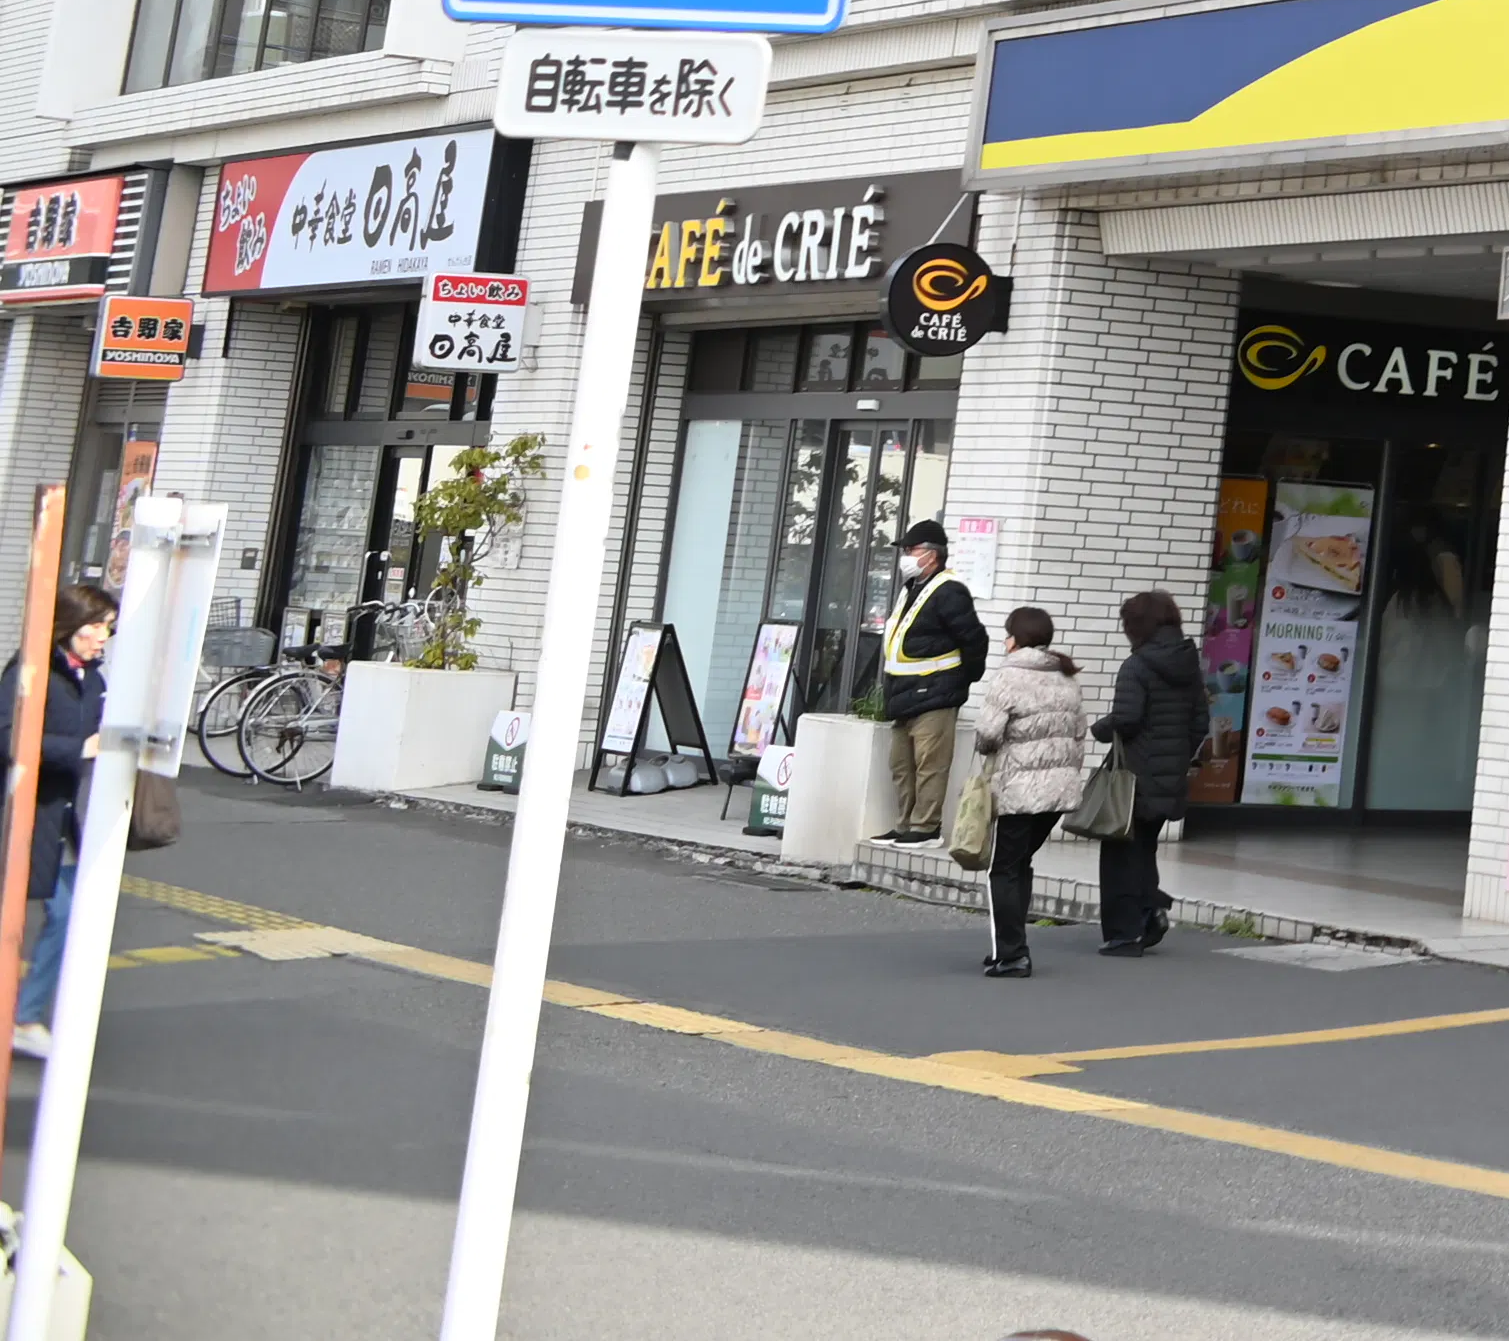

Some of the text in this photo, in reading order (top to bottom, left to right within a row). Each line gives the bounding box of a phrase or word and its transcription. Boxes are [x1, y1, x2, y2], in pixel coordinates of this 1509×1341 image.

[525, 53, 737, 117] 自転車を除く
[218, 174, 257, 233] ちょい
[291, 139, 458, 254] 中華食堂 日高屋
[235, 212, 267, 276] 飲み
[645, 184, 884, 290] AFÉ de CRIÉ
[438, 279, 523, 302] ちょい飲み
[448, 309, 506, 330] 中華食堂
[911, 325, 967, 342] de CRIÉ
[919, 310, 963, 328] CAFÉ
[429, 331, 518, 364] 日高屋
[1337, 341, 1500, 402] CAFÉ
[1265, 621, 1324, 641] MORNING
